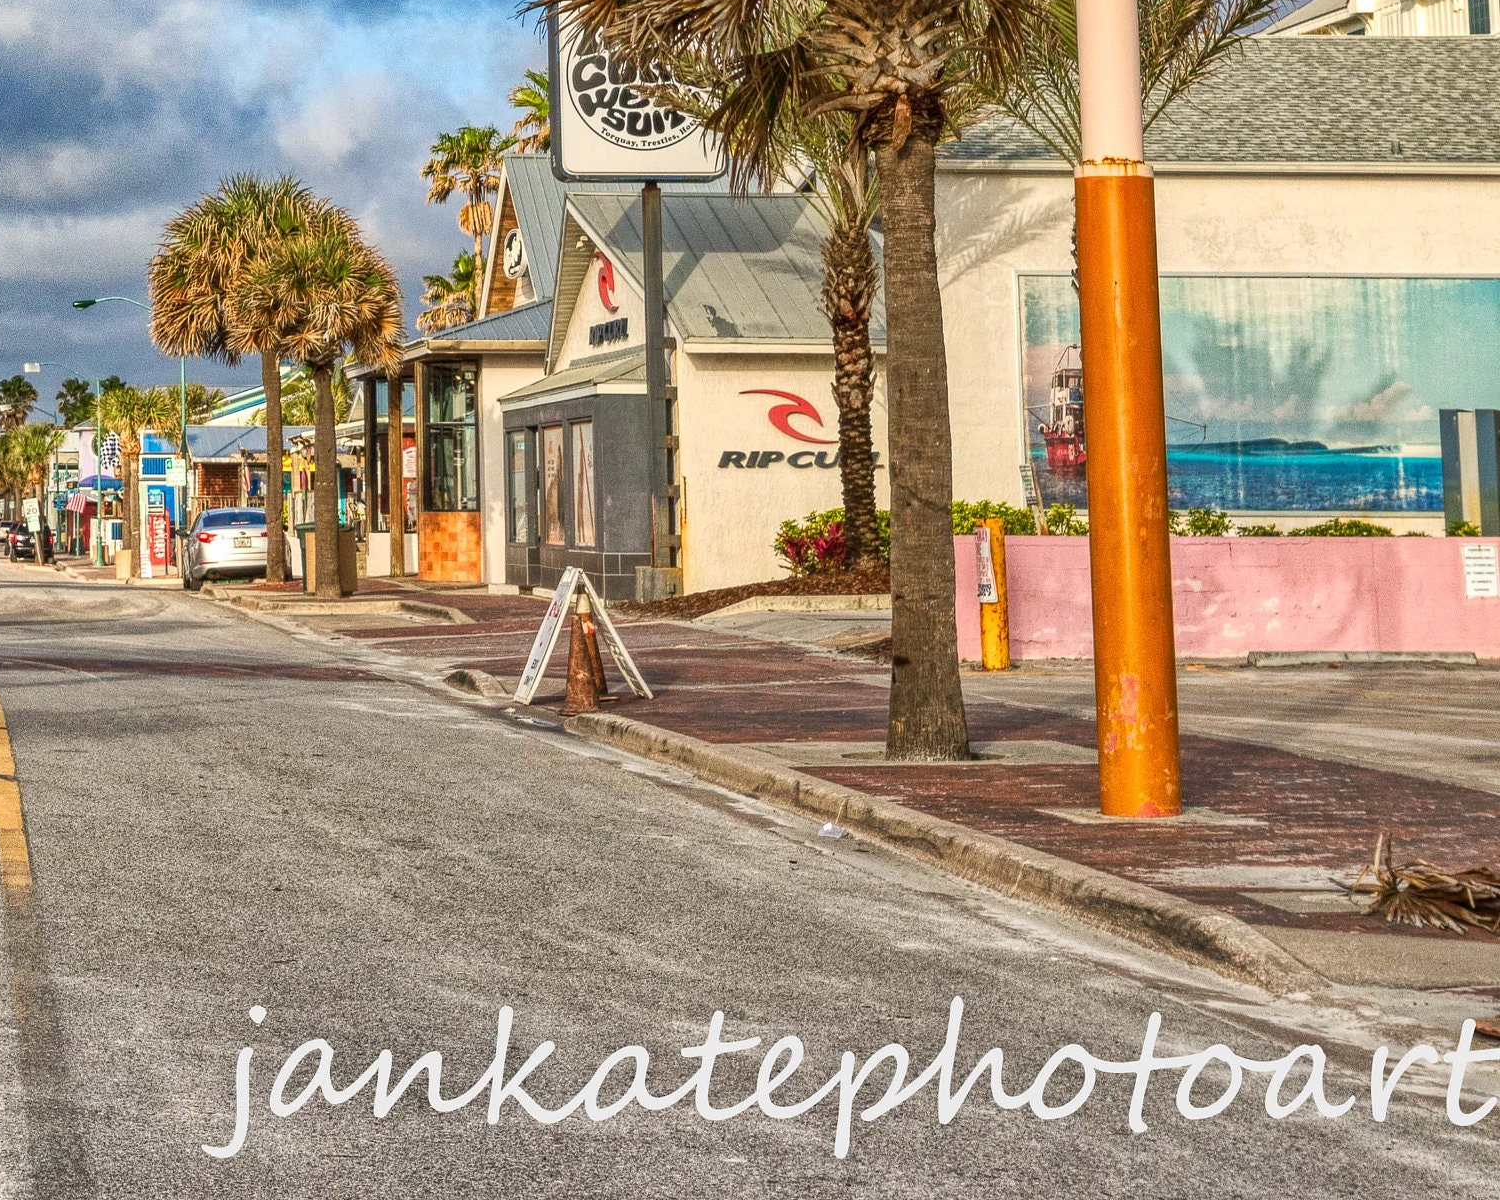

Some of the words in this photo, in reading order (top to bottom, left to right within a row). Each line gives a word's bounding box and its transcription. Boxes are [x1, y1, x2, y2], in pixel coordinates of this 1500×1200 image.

[601, 107, 686, 137] SUIT
[600, 126, 638, 147] Torquay,
[640, 133, 680, 147] Trestles,
[718, 451, 784, 469] RIP
[786, 451, 885, 469] CUL
[26, 507, 38, 515] 20
